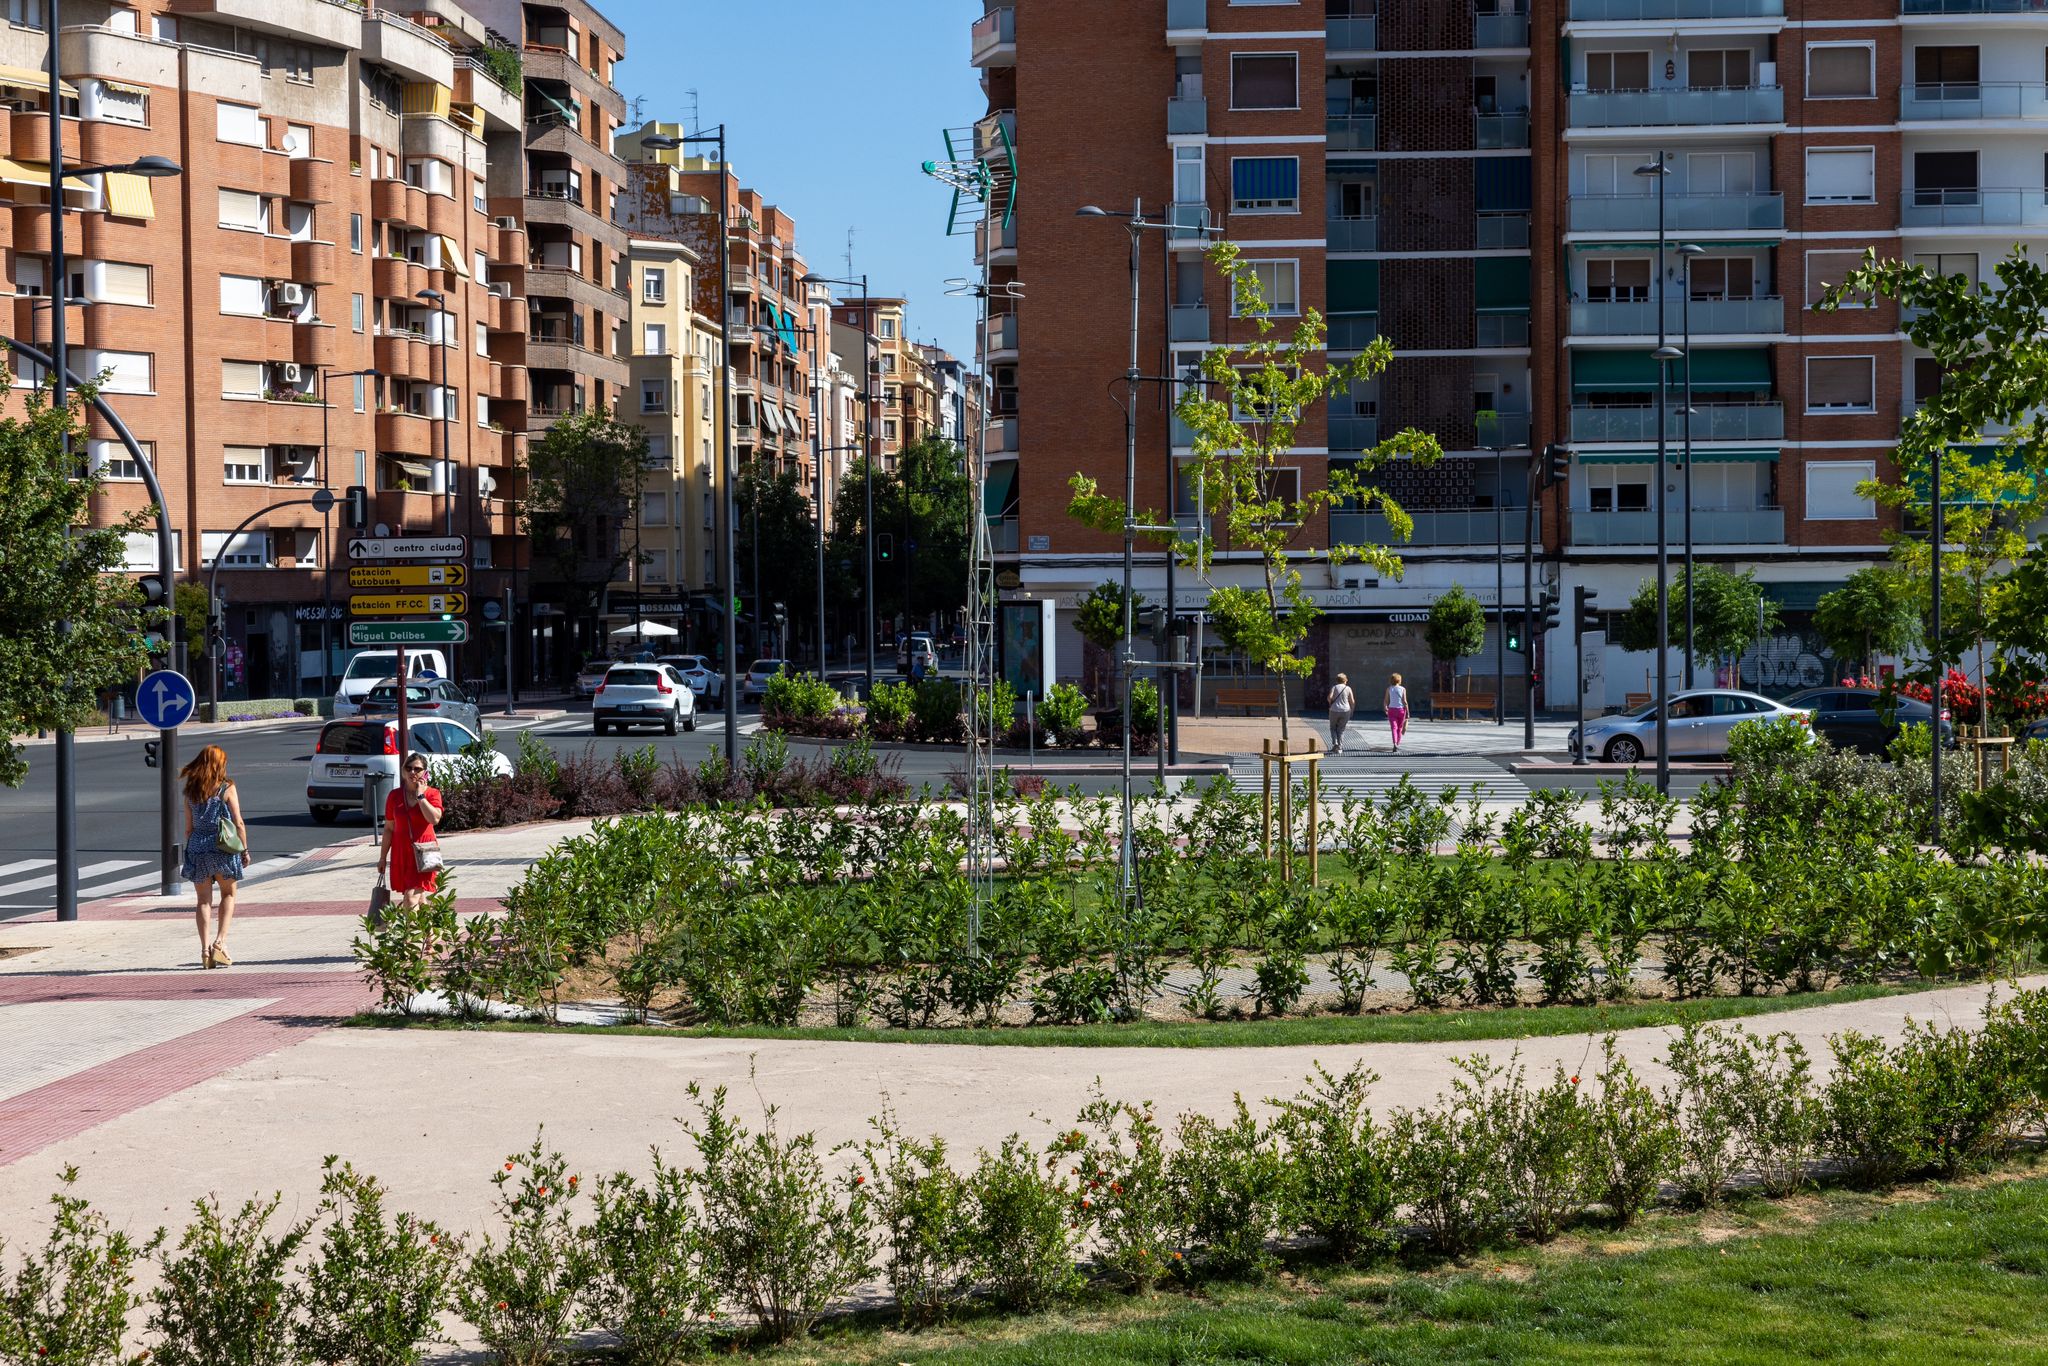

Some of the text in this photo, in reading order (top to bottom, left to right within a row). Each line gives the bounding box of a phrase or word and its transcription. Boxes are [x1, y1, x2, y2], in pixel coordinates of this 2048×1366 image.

[393, 543, 462, 552] centro ciudad
[351, 568, 391, 576] estación
[350, 578, 400, 586] autobuses
[351, 598, 425, 609] estación FF.CC.
[640, 604, 683, 612] ROSSANA
[1388, 614, 1430, 622] CIUDAD
[352, 632, 426, 642] Miguel Delibes
